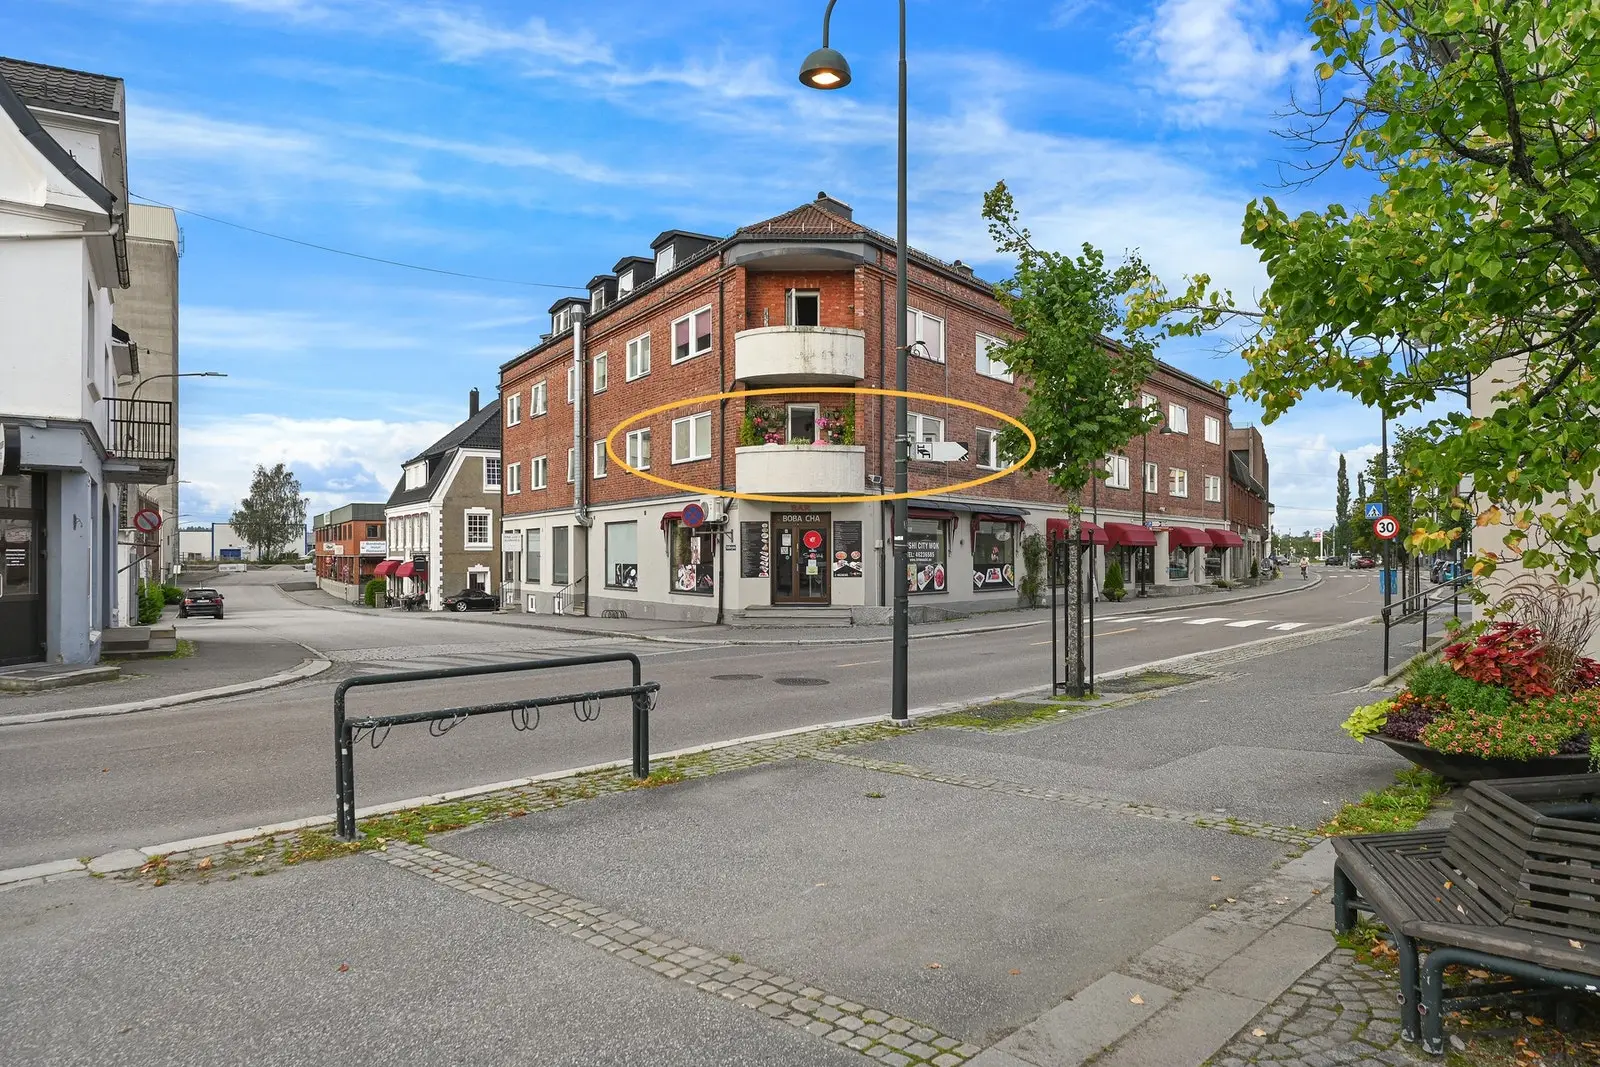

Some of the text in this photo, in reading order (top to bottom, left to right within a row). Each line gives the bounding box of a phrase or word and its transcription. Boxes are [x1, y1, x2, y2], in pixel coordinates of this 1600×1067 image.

[782, 514, 821, 522] BOBA CHA
[1379, 521, 1394, 533] 30
